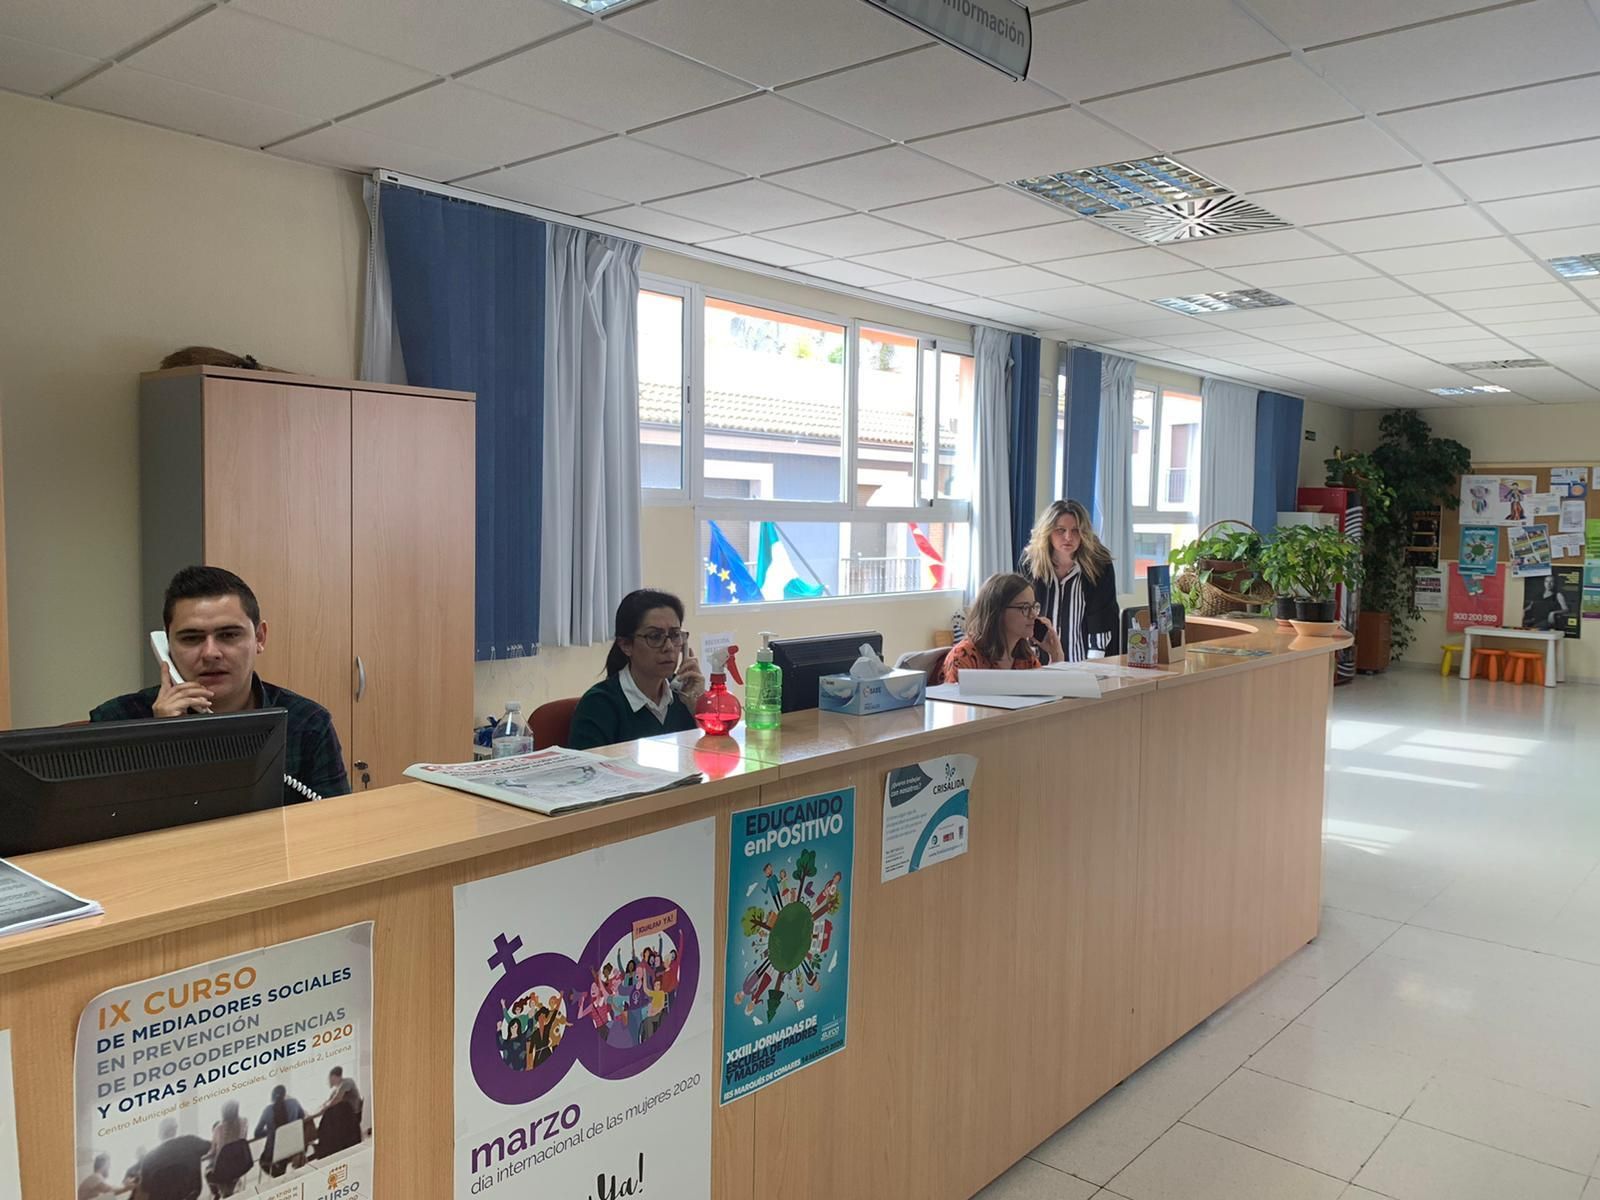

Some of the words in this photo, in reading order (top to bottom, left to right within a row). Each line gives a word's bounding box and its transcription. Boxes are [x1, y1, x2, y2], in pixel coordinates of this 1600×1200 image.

[943, 0, 1024, 47] nformación
[1468, 613, 1482, 621] 200
[744, 814, 843, 857] enPOSITIVO
[746, 795, 843, 836] EDUCANDO
[97, 1033, 125, 1054] DE
[132, 994, 262, 1043] MEDIADORES
[267, 967, 352, 1002] SOCIALES
[98, 1000, 131, 1030] IX
[144, 966, 257, 1015] CURSO
[97, 1055, 125, 1075] EN
[133, 1014, 259, 1065] PREVENCIÓN
[98, 1077, 126, 1098] DE
[133, 1008, 346, 1087] DROGODEPENDENCIAS
[727, 1047, 769, 1073] ESCUELA
[770, 1040, 782, 1055] DE
[783, 1025, 818, 1048] PADRES
[752, 1021, 804, 1052] JORNADAS
[805, 1014, 818, 1030] DE
[97, 1104, 111, 1119] Y
[118, 1079, 187, 1112] OTRAS
[193, 1039, 306, 1088] ADICCIONES
[312, 1024, 353, 1048] 2020
[97, 1121, 131, 1137] Centro
[132, 1104, 177, 1126] Municipal
[180, 1101, 190, 1109] de
[192, 1087, 230, 1104] Servicios
[325, 1045, 352, 1058] Lucena
[726, 1072, 733, 1086] Y
[734, 1055, 776, 1081] MADRES
[471, 1104, 581, 1174] marzo
[497, 1128, 584, 1183] internacional
[586, 1122, 603, 1139] de
[606, 1113, 623, 1130] las
[625, 1089, 671, 1120] mujeres
[673, 1073, 701, 1096] 2020
[318, 1181, 360, 1200] URSO
